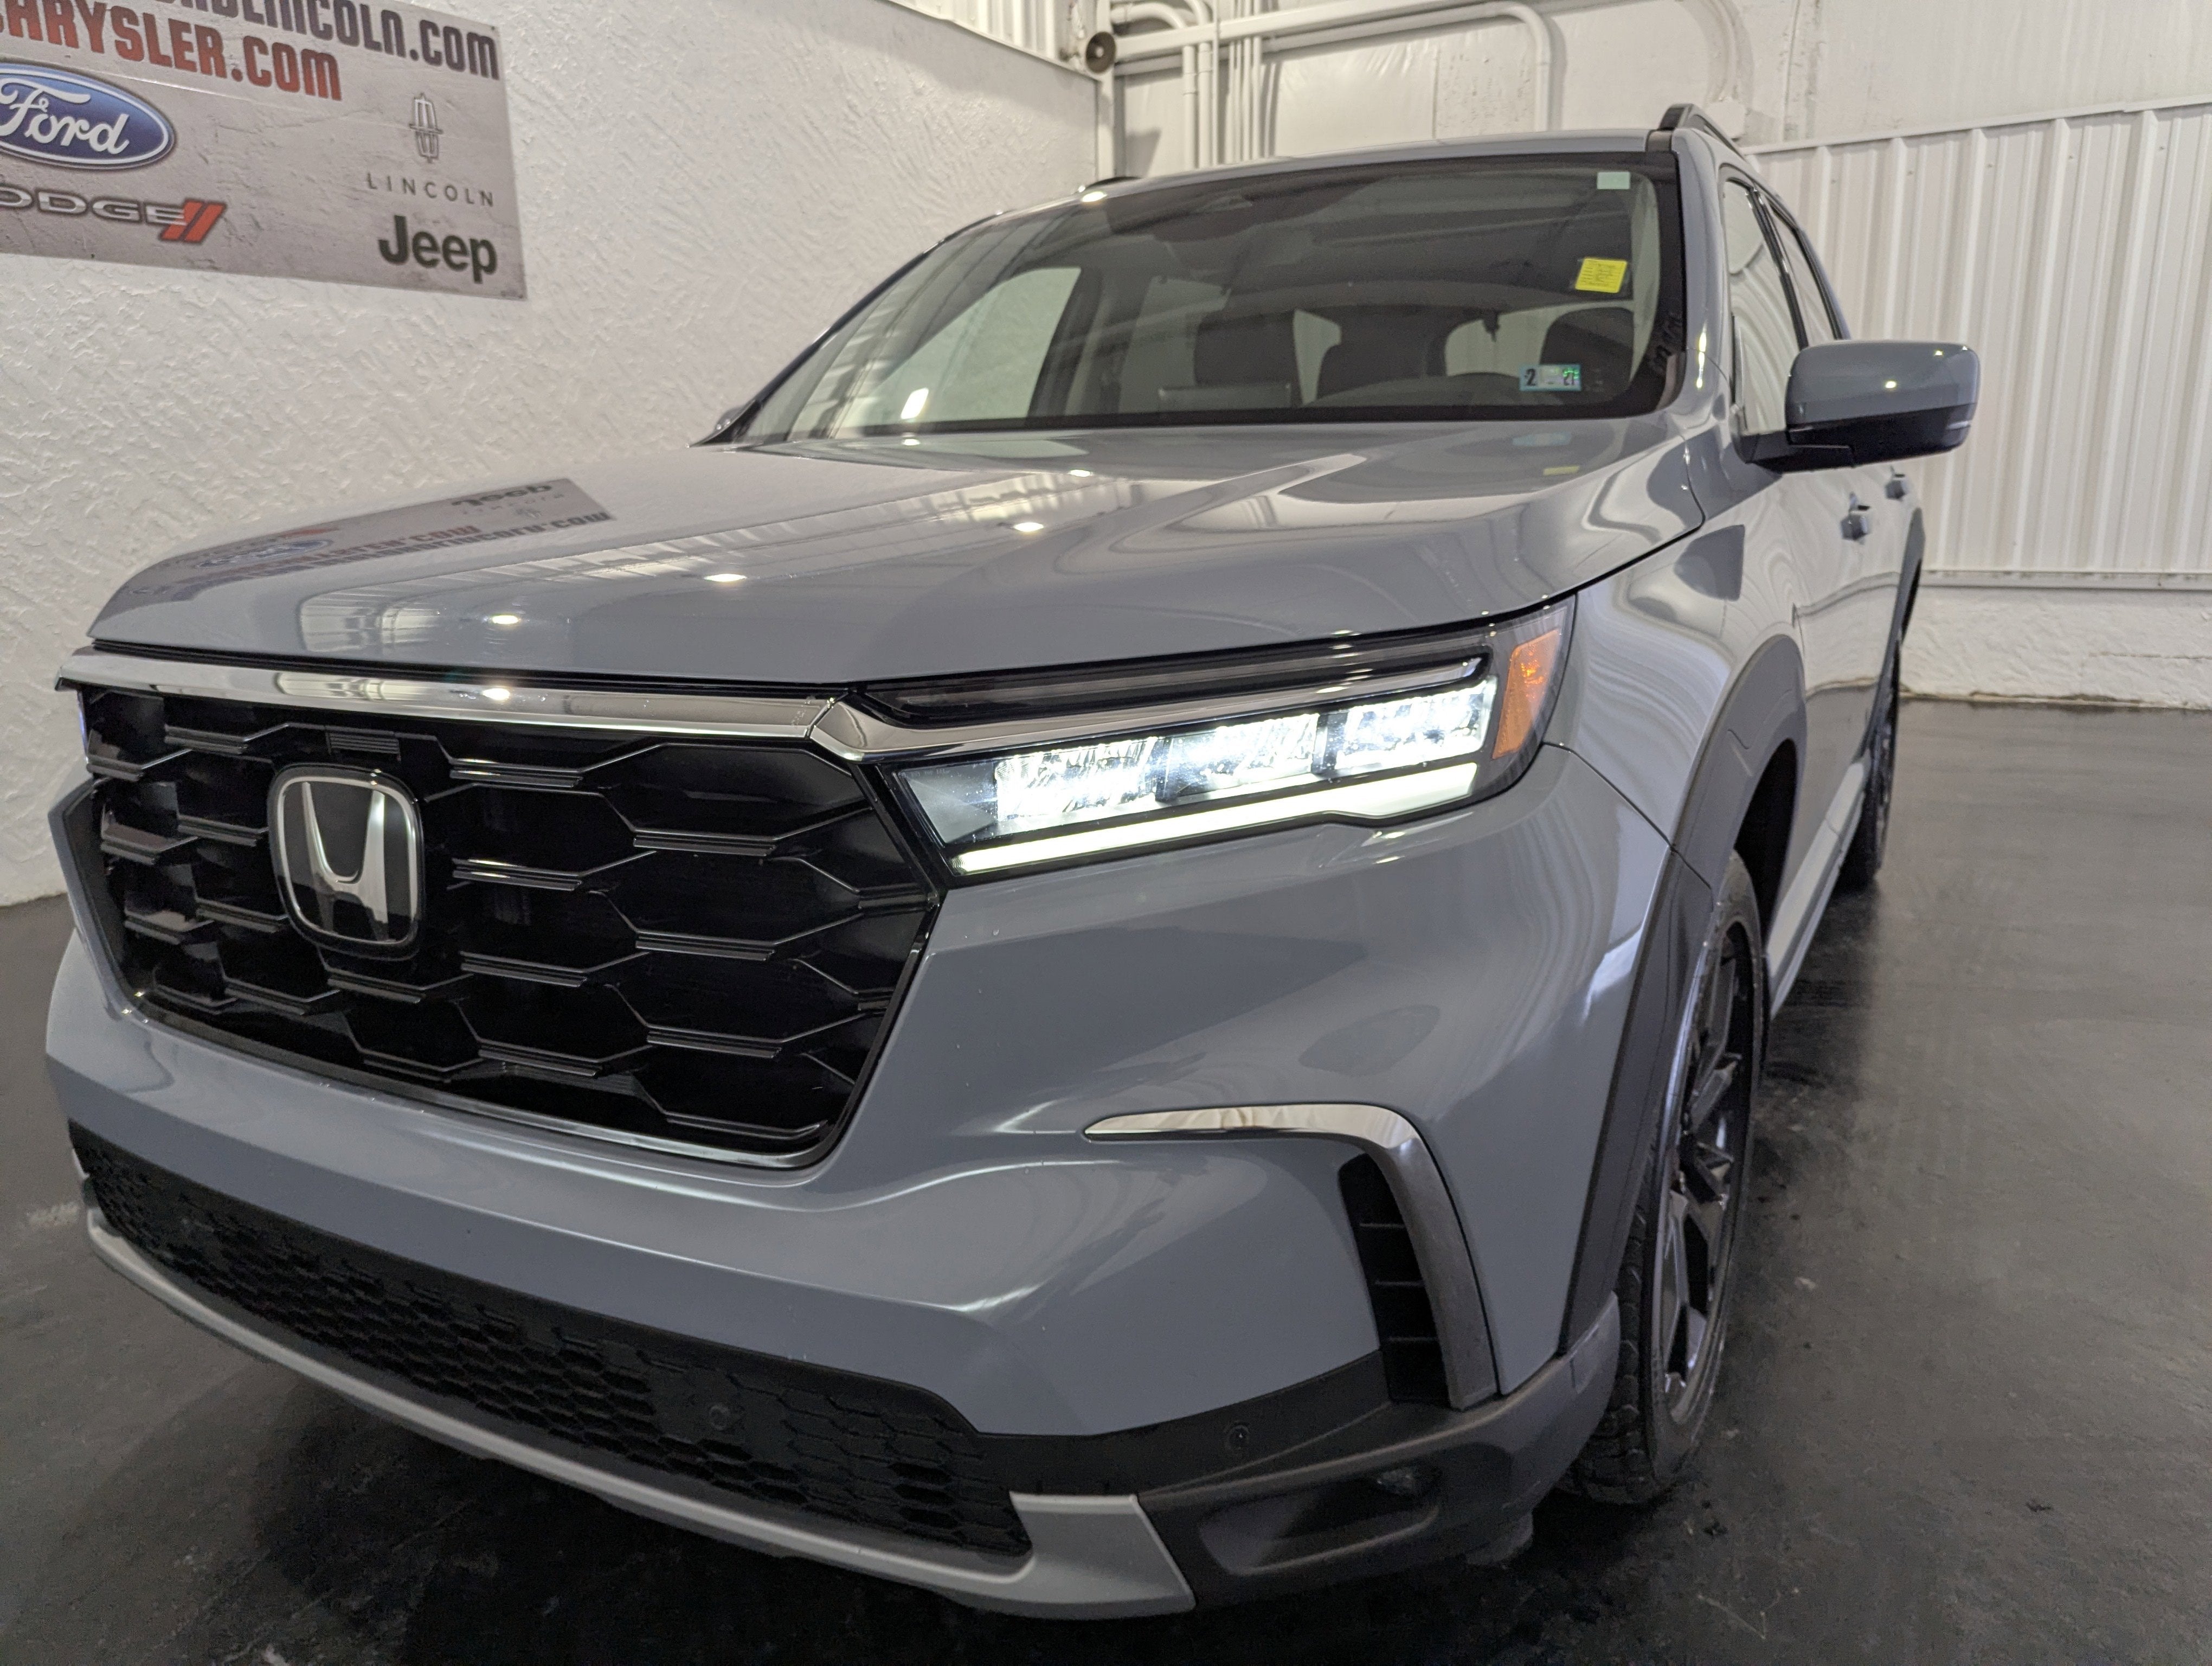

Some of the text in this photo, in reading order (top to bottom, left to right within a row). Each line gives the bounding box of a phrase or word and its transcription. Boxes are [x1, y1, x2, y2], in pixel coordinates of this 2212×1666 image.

[0, 0, 342, 101] HRYSLER.COM
[152, 0, 500, 80] LINCOLN.COM
[0, 78, 130, 155] Ford
[366, 172, 494, 207] LINCOLN
[378, 214, 498, 284] Jeep
[1524, 368, 1536, 386] 2
